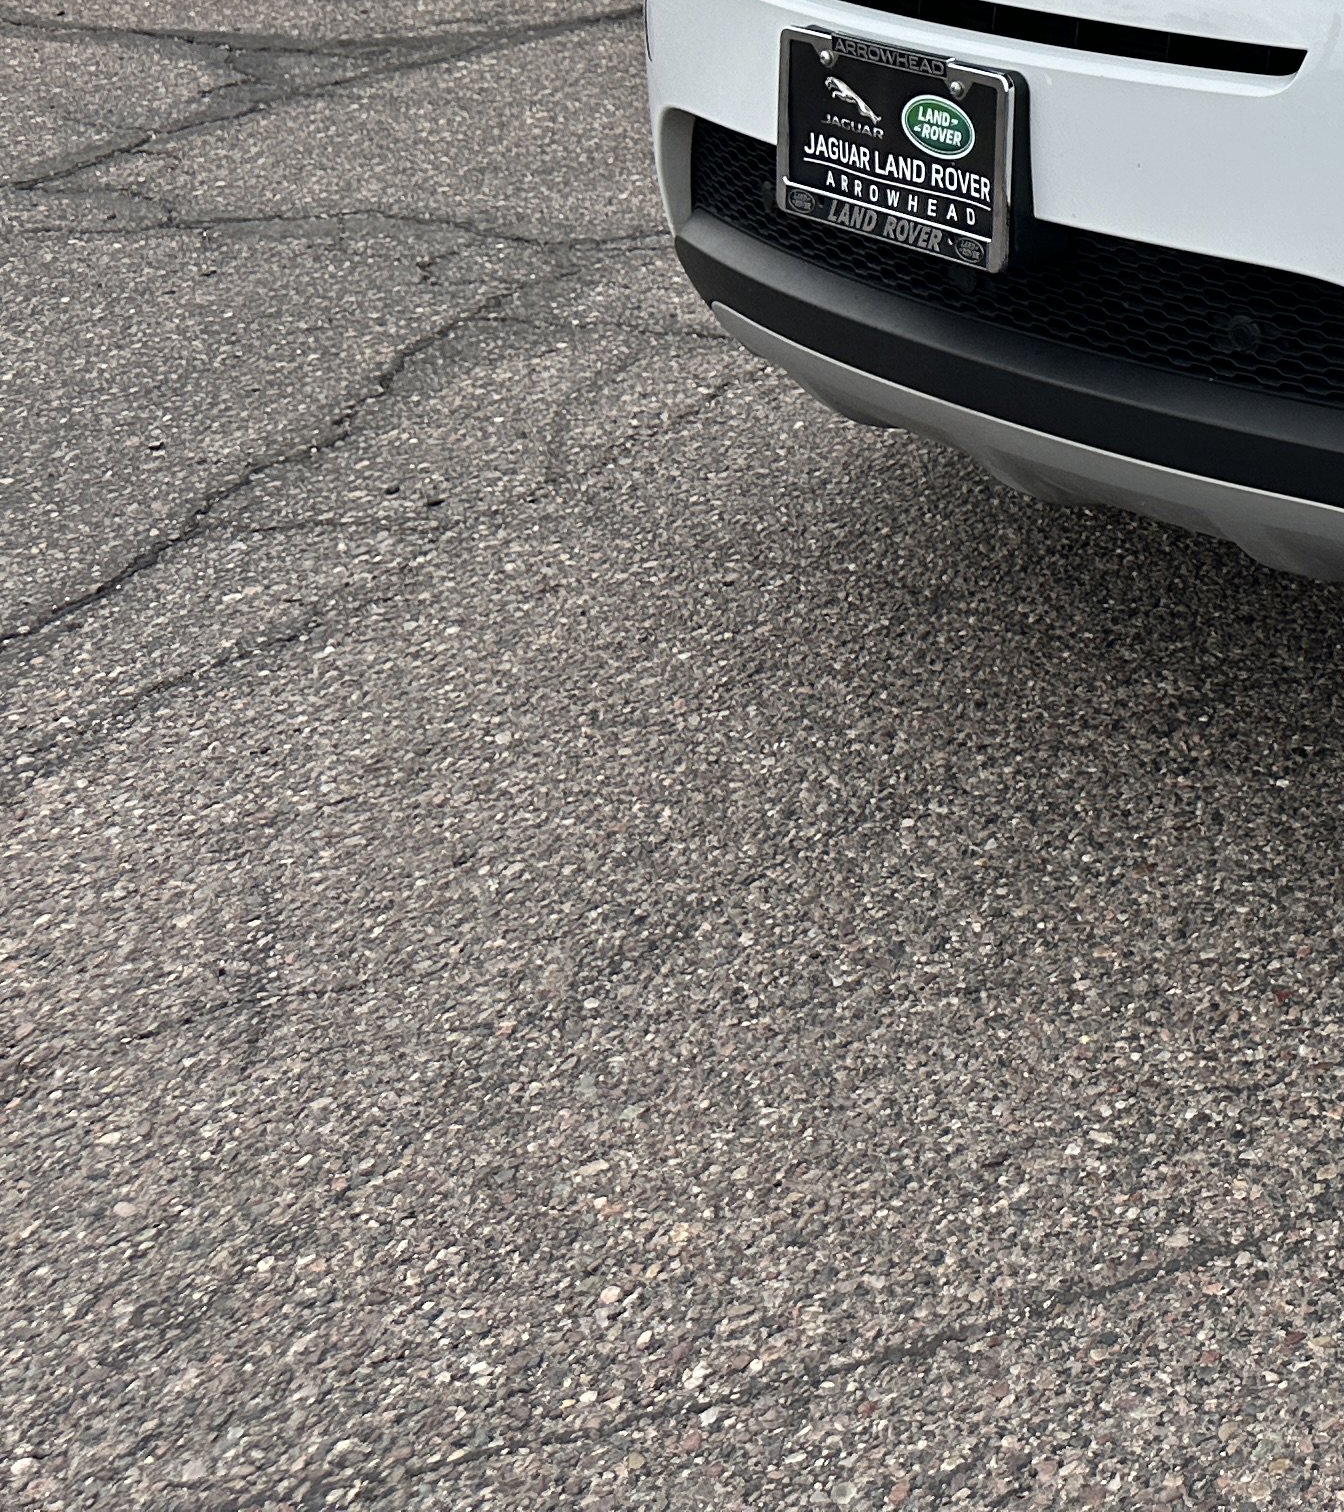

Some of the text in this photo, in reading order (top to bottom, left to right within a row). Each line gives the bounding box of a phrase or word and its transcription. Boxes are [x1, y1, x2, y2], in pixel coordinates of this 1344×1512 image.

[835, 38, 945, 76] ARROWHEAD
[821, 113, 884, 140] JAGUAR
[917, 106, 952, 126] LAND
[920, 123, 963, 147] ROVER
[804, 133, 991, 203] JAGUAR LAND ROVER
[826, 170, 976, 226] ARROWHEAD
[827, 199, 943, 253] LAND ROVER
